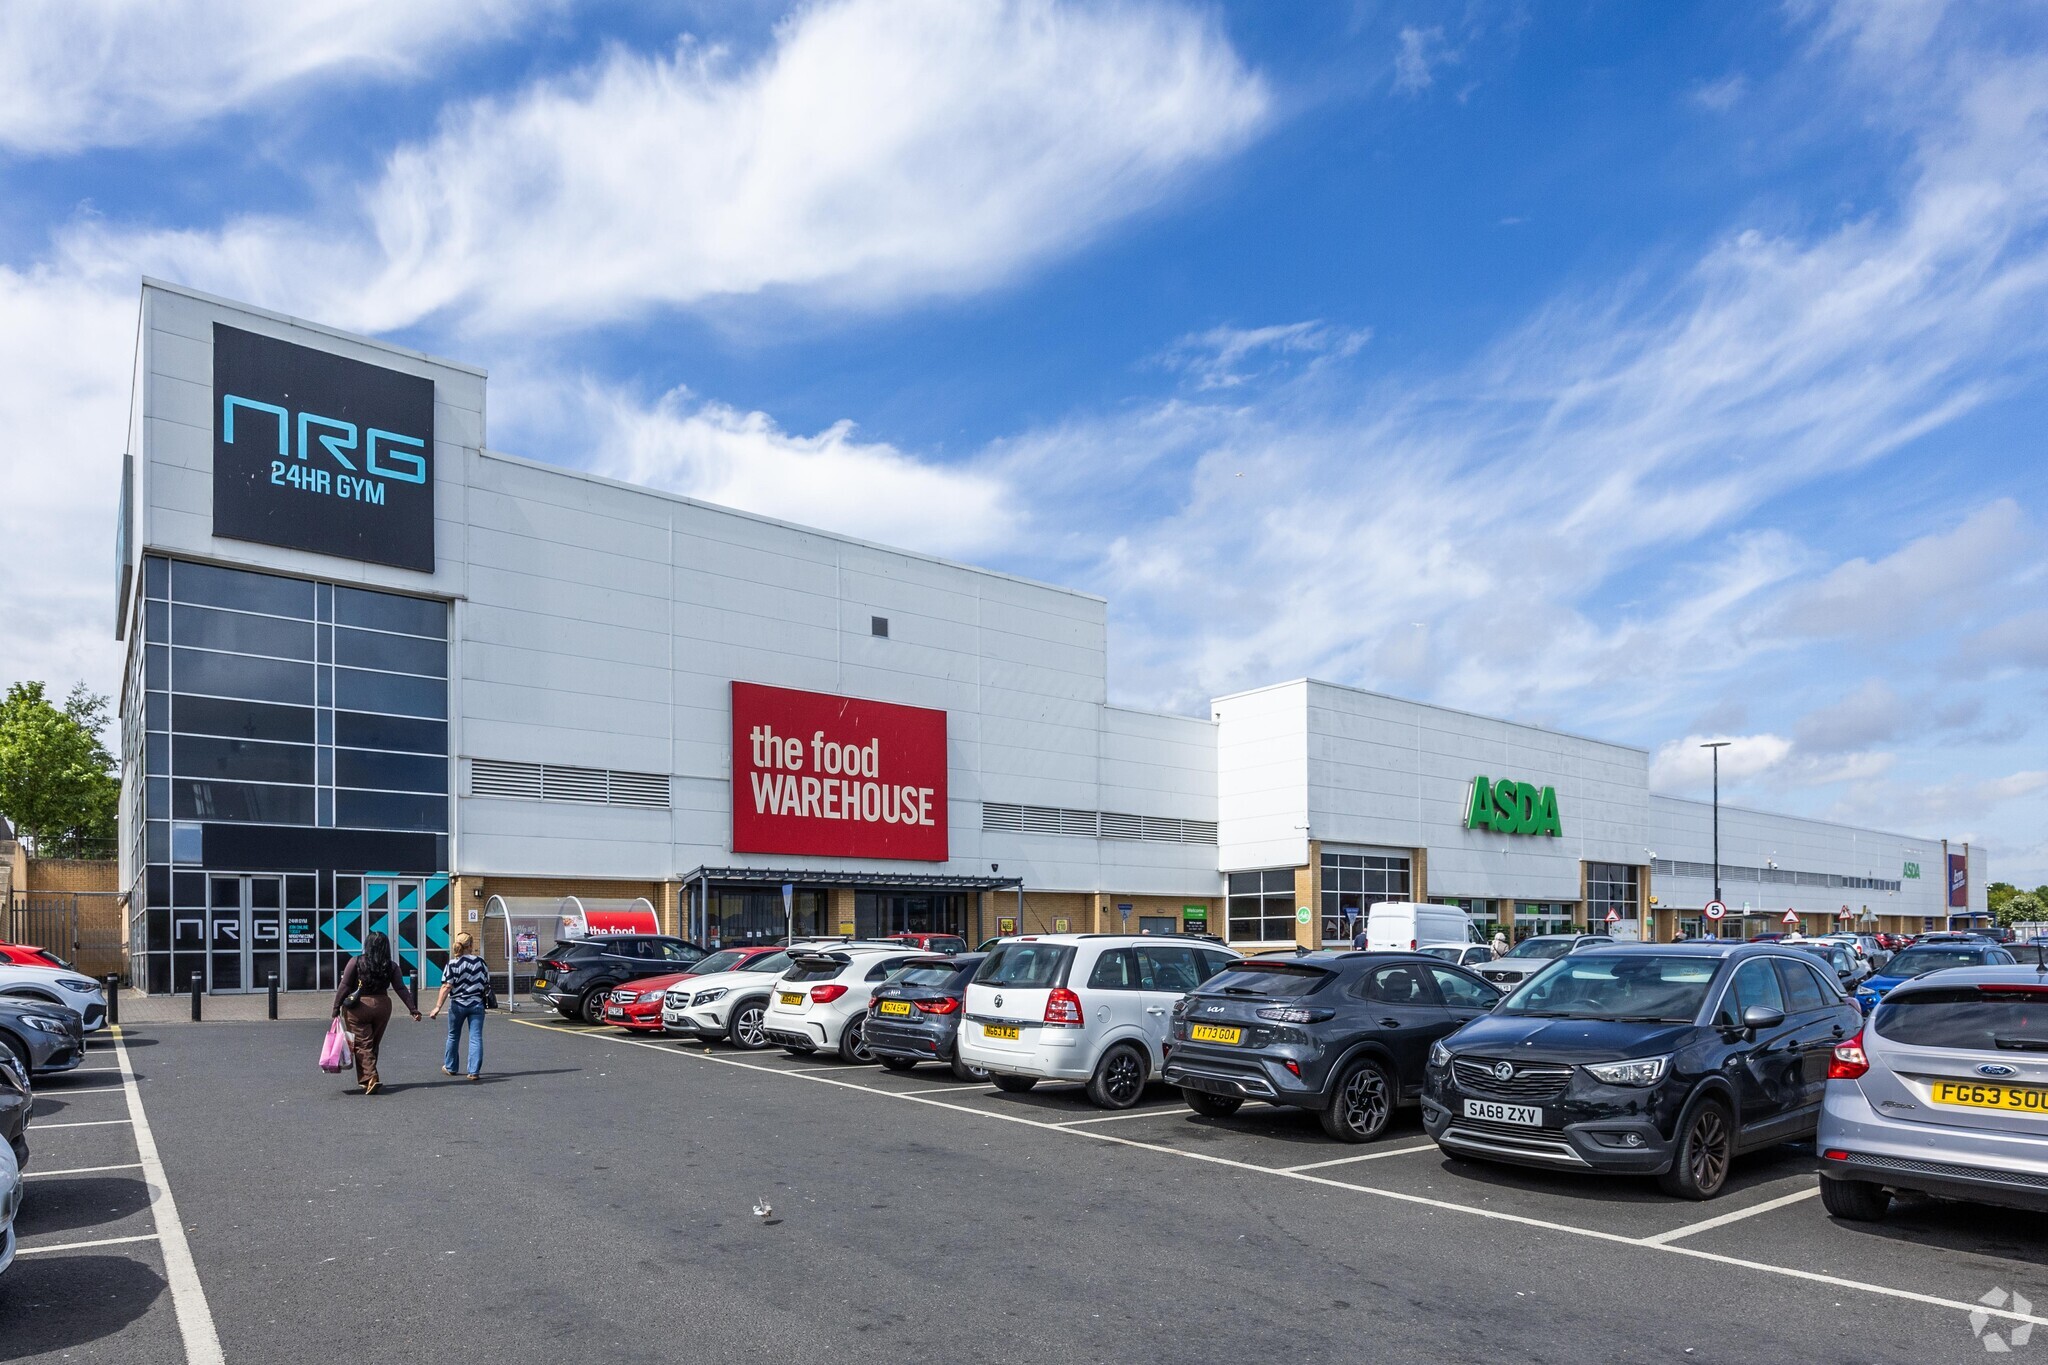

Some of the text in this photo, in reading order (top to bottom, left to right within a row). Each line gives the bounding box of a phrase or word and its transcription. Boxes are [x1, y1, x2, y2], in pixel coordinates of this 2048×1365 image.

[271, 460, 385, 505] 24HR GYM
[749, 725, 879, 778] the food
[750, 771, 935, 826] WAREHOUSE
[1467, 776, 1563, 838] ASDA
[1903, 861, 1921, 880] ASDA
[1711, 905, 1720, 916] 5
[589, 926, 606, 934] the
[610, 926, 636, 934] food
[1197, 1026, 1235, 1040] YT73 GOA
[1985, 1065, 2006, 1075] Ford
[1940, 1084, 2001, 1104] FG63
[1470, 1102, 1536, 1123] SA68 ZXV
